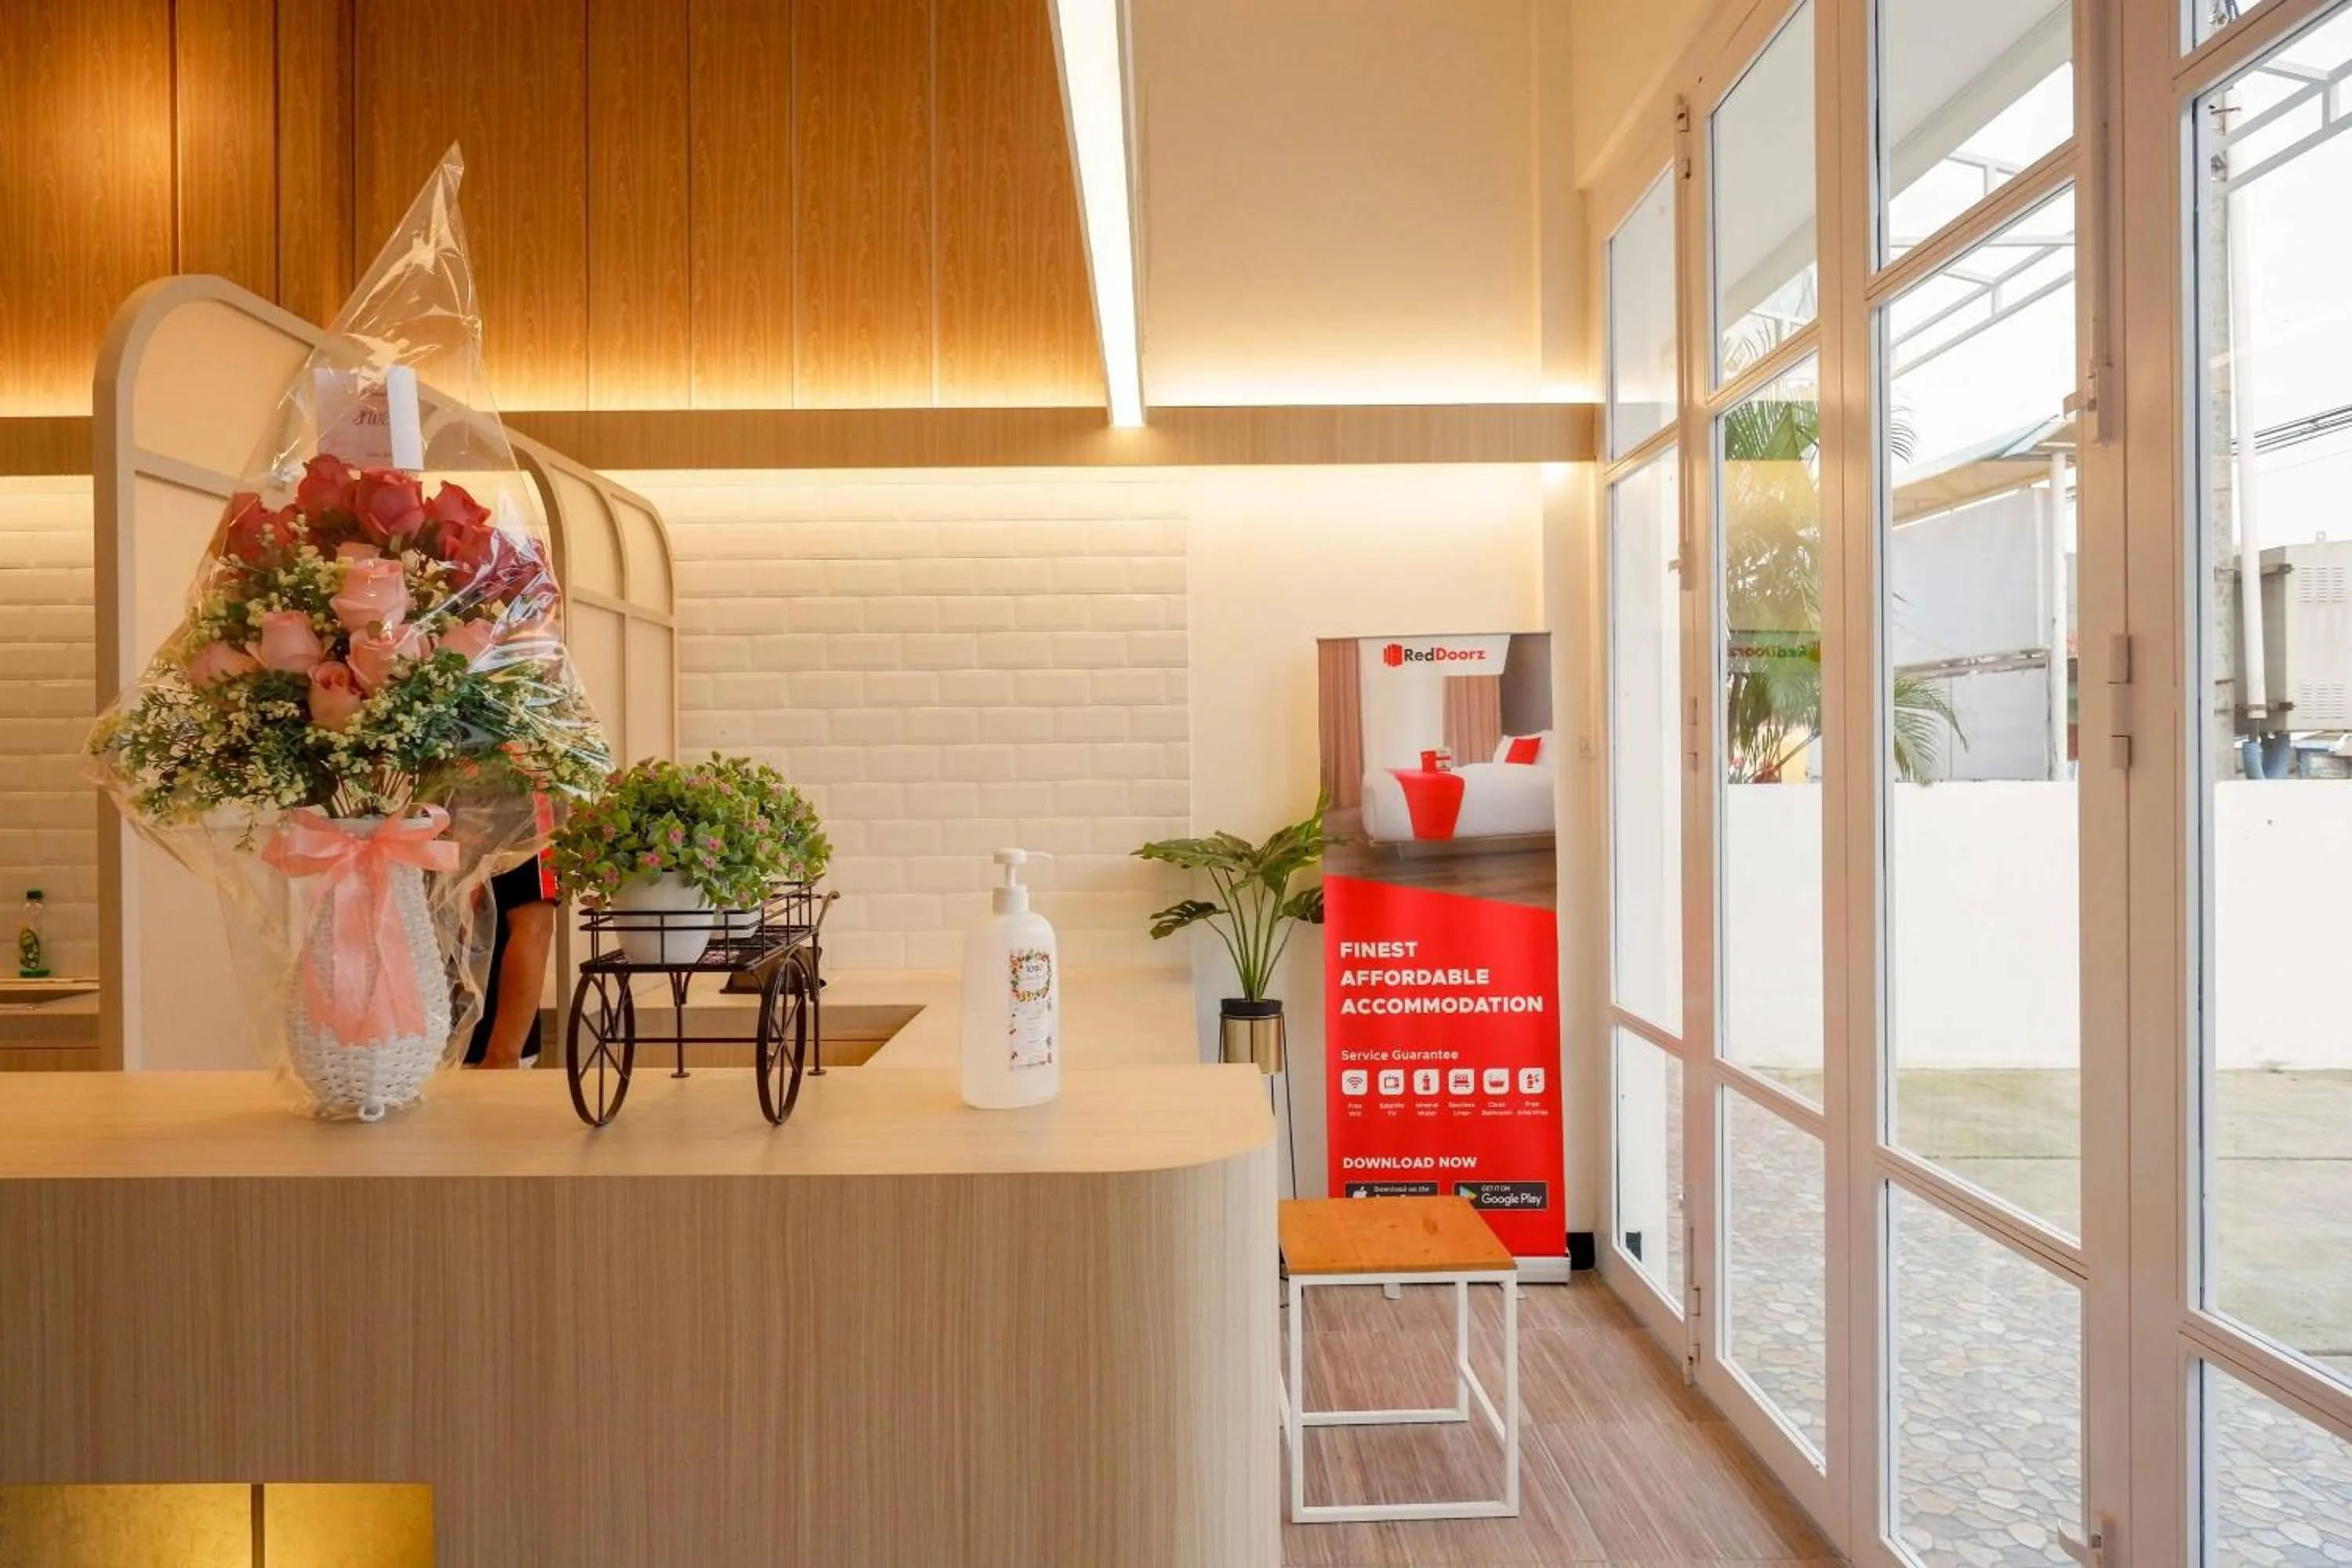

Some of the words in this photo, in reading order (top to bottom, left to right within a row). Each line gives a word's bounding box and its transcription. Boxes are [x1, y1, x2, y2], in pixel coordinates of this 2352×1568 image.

[1404, 647, 1486, 661] RedDoorz
[1340, 942, 1417, 958] FINEST
[1340, 969, 1490, 986] AFFORDABLE
[1341, 996, 1544, 1014] ACCOMMODATION
[1341, 1050, 1388, 1061] Service
[1392, 1049, 1459, 1061] Guarantee
[1343, 1157, 1435, 1169] DOWNLOAD
[1439, 1156, 1478, 1168] NOW
[1481, 1192, 1519, 1206] Google
[1520, 1192, 1542, 1207] Play
